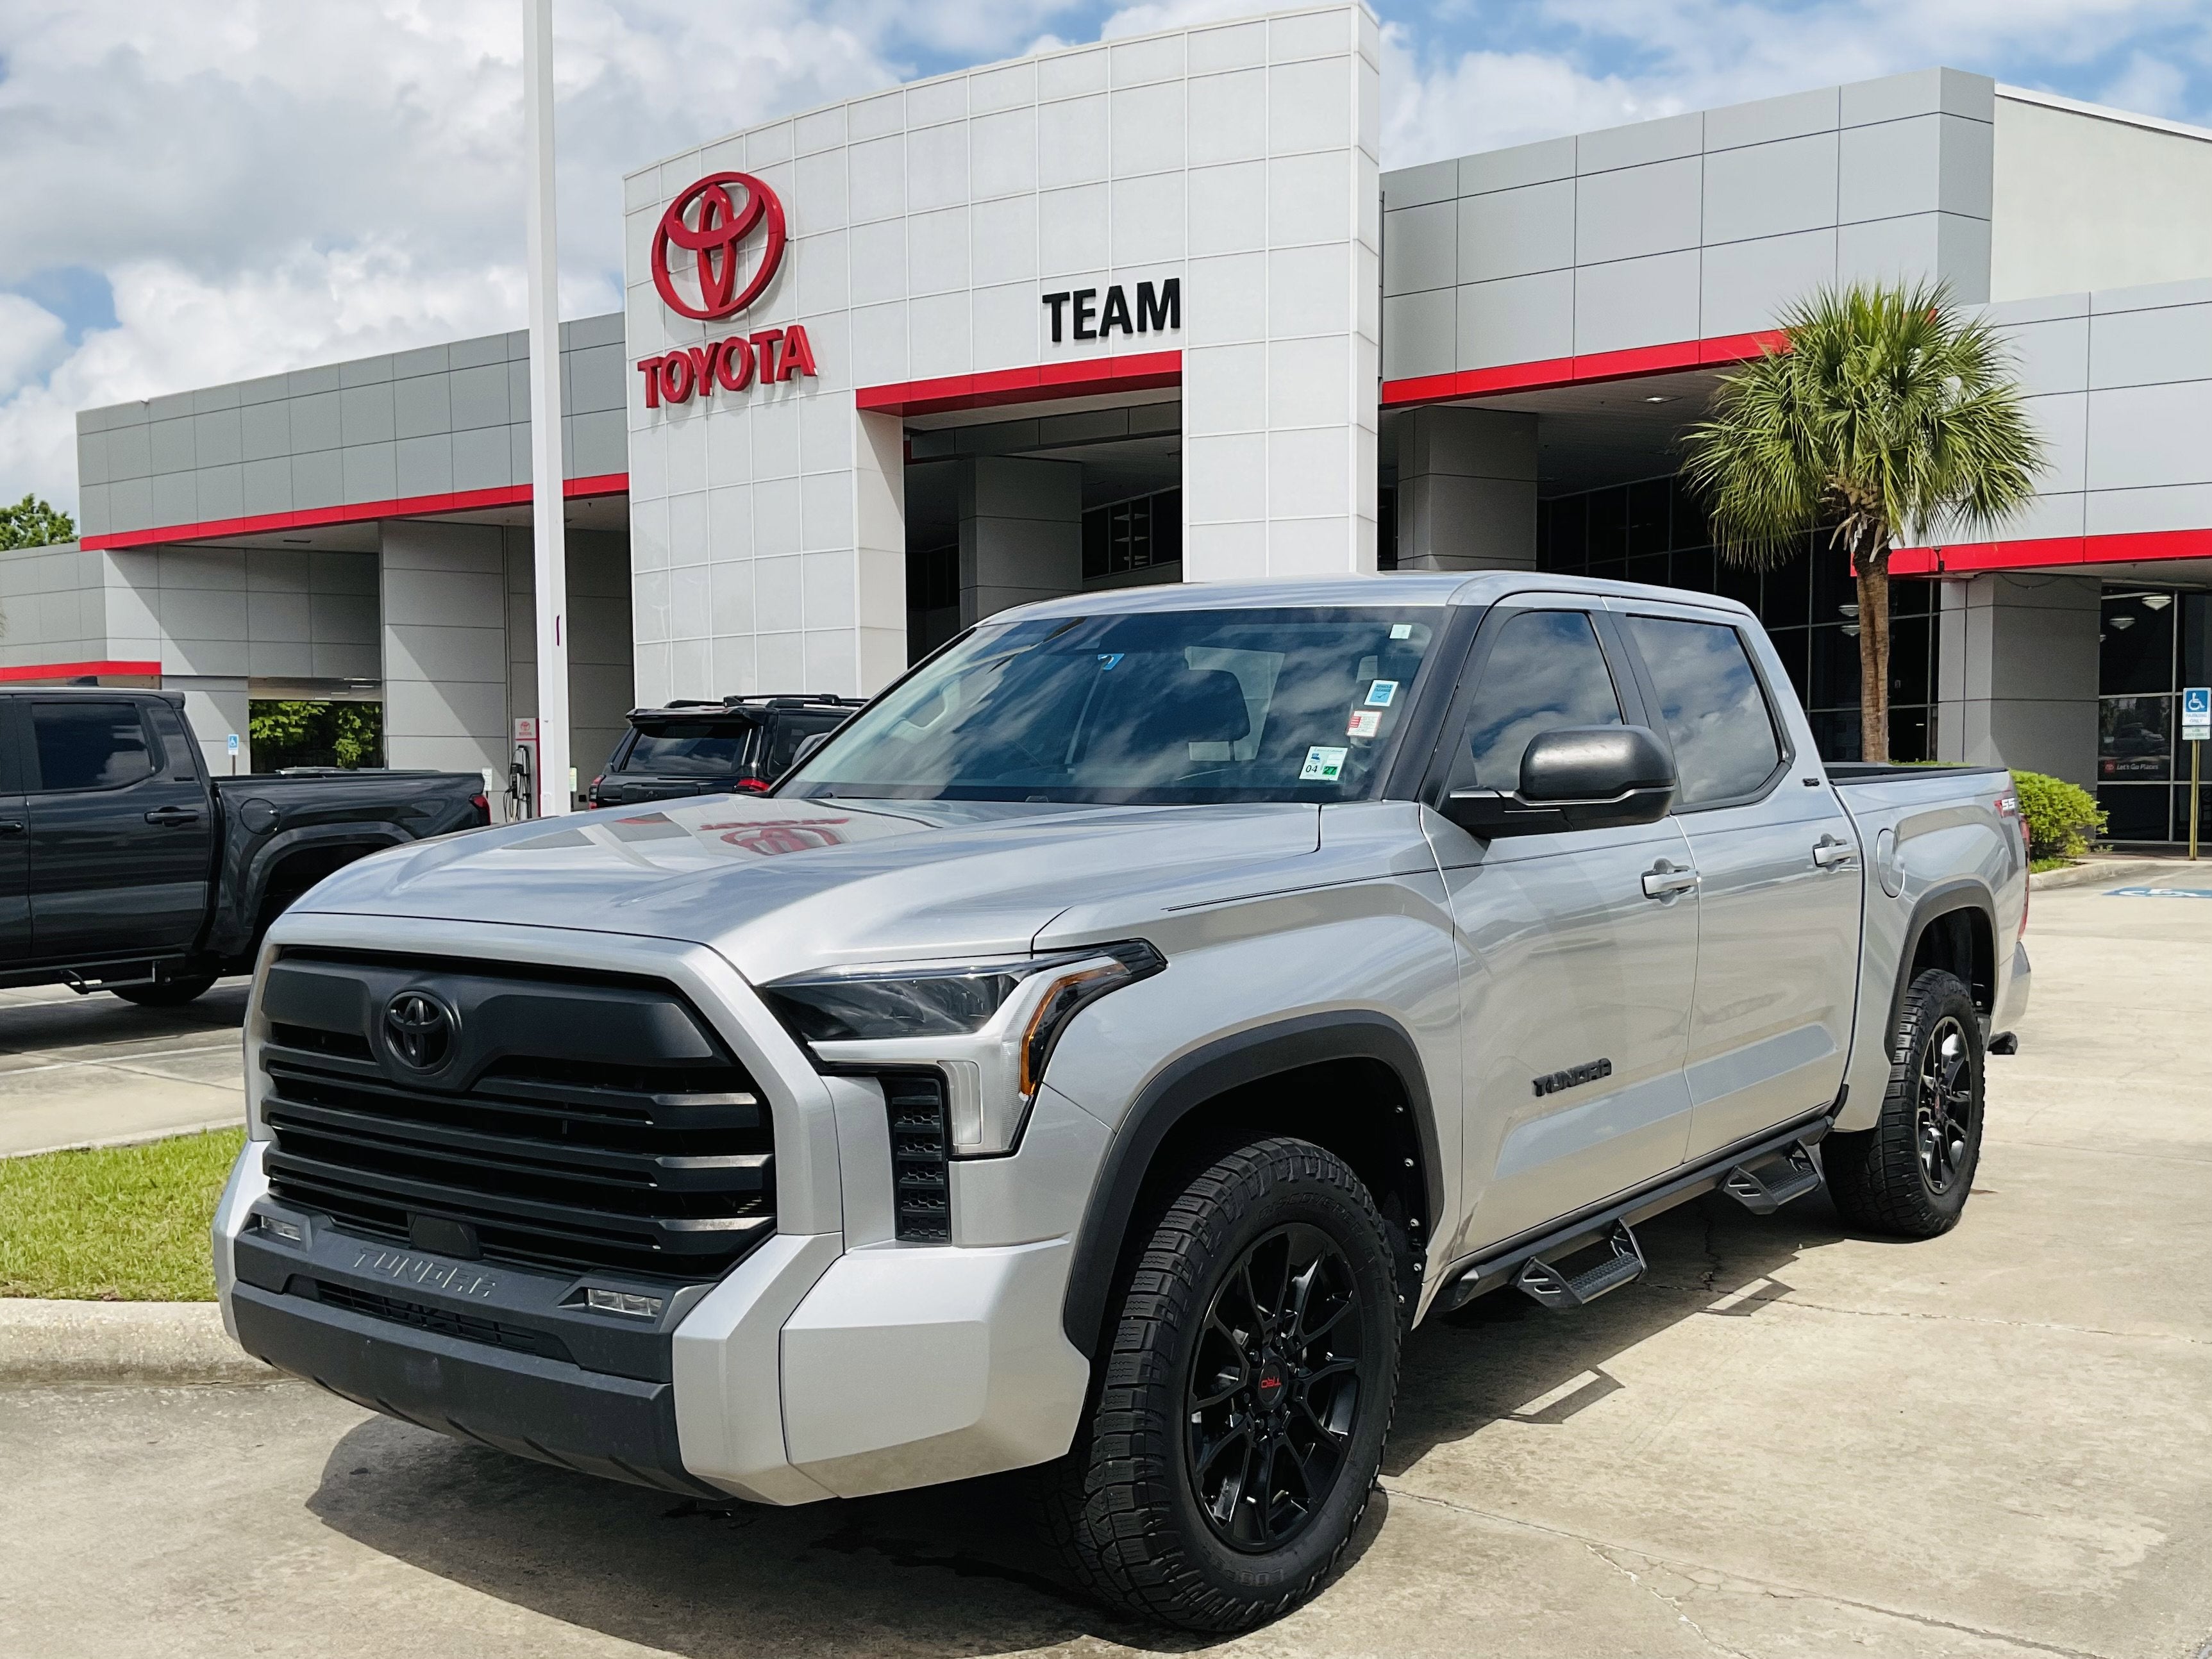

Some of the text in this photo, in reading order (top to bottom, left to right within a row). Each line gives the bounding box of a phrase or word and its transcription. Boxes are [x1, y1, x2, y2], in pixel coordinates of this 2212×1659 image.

[1042, 278, 1180, 342] TEAM
[637, 325, 817, 408] TOYOTA
[1305, 765, 1337, 774] 04 27
[1532, 1058, 1613, 1097] TUNDRA
[354, 1247, 497, 1297] TUNDRA
[1261, 1376, 1282, 1389] TRD
